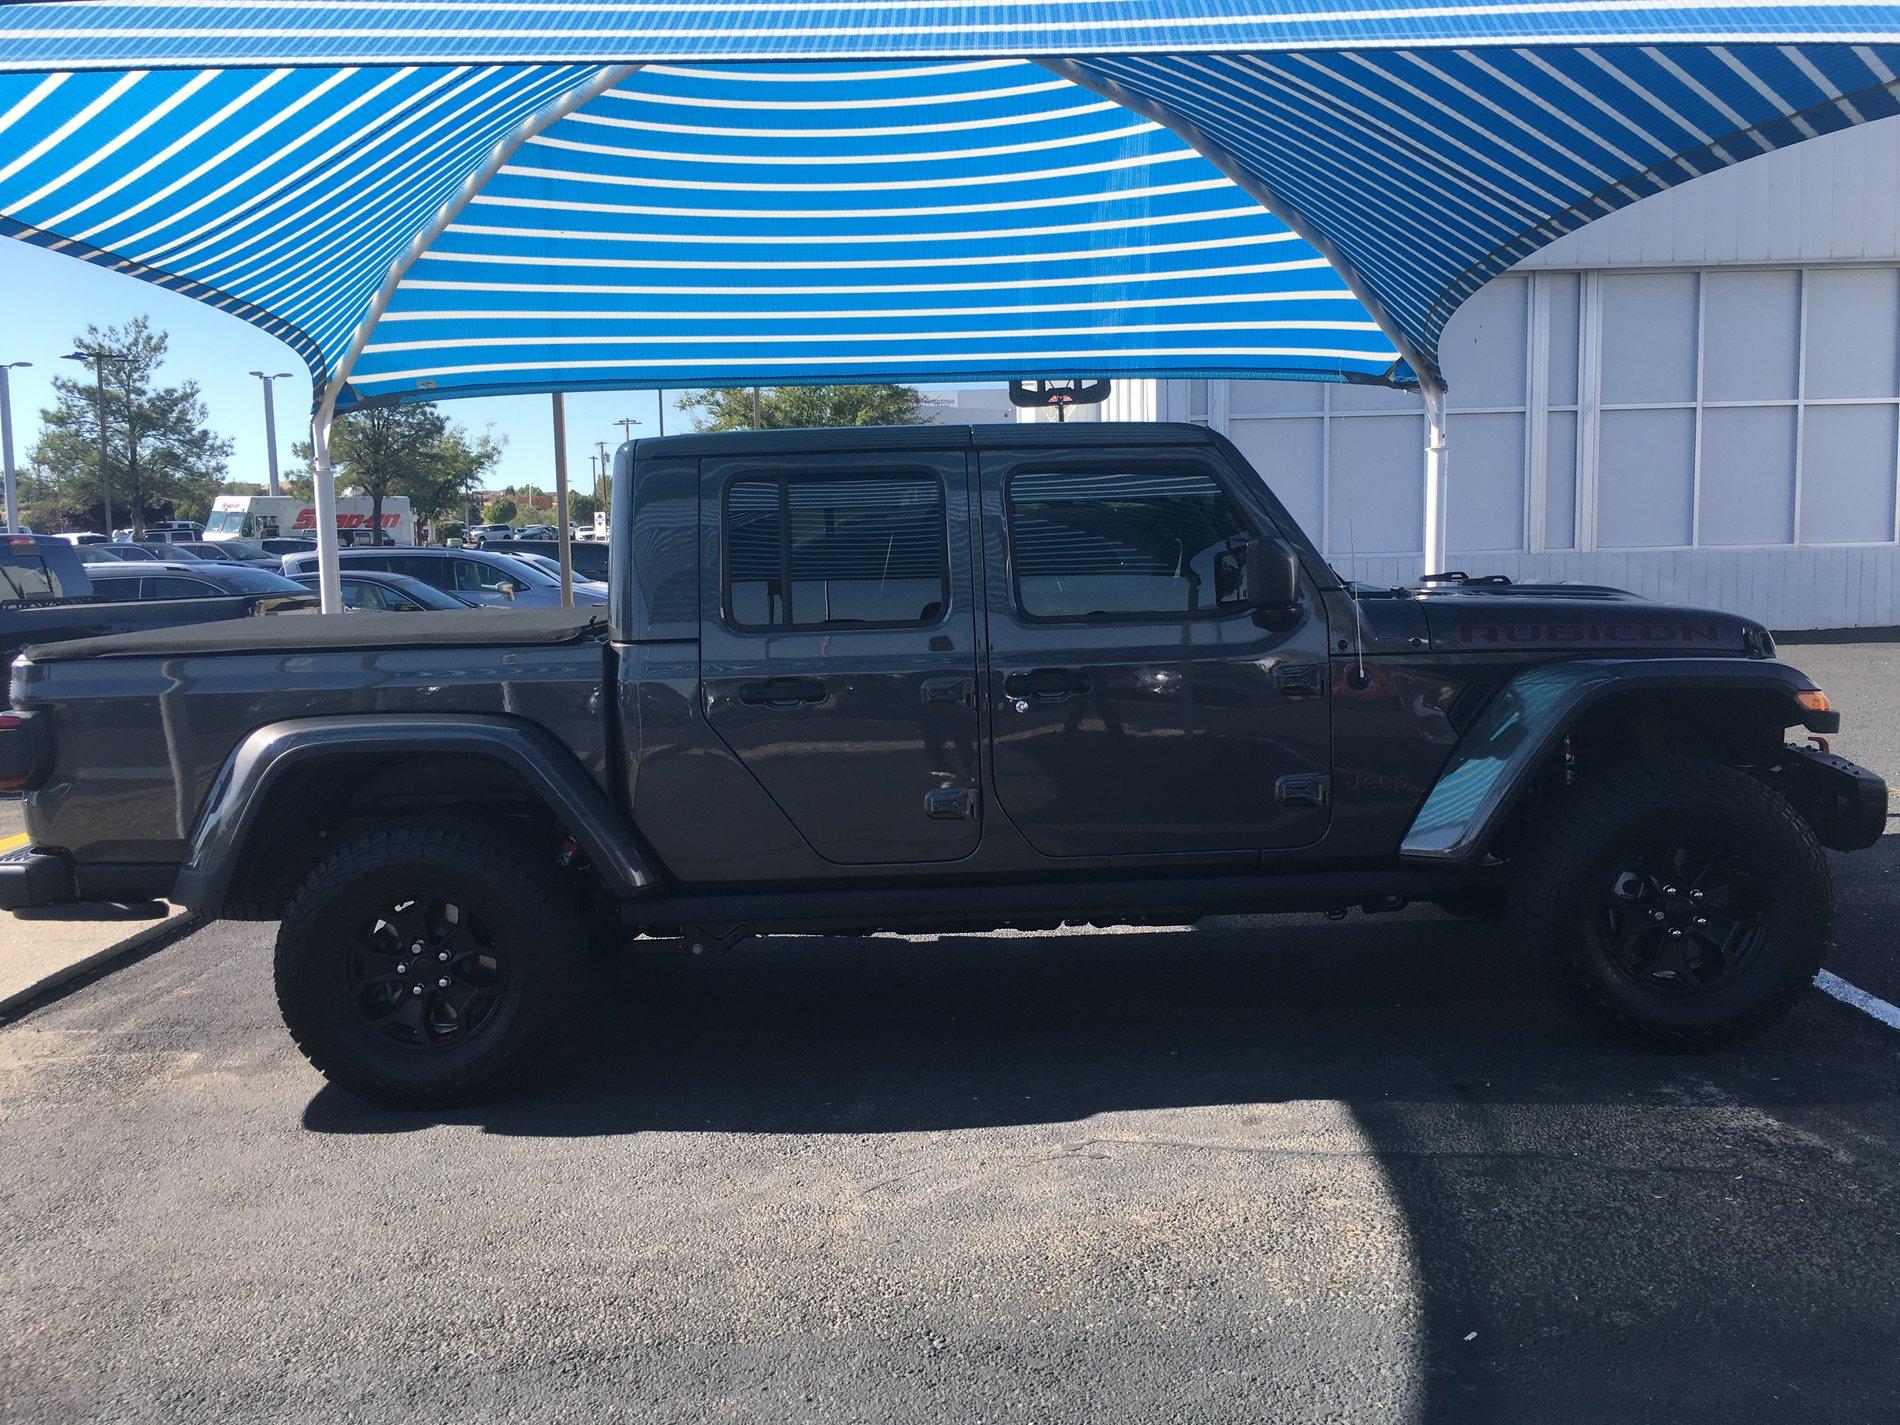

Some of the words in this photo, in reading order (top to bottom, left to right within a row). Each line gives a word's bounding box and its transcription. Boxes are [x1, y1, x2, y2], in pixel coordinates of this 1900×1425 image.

[291, 508, 402, 529] Sap-on
[1457, 623, 1721, 643] RUBICON
[1344, 770, 1408, 793] Jeep
